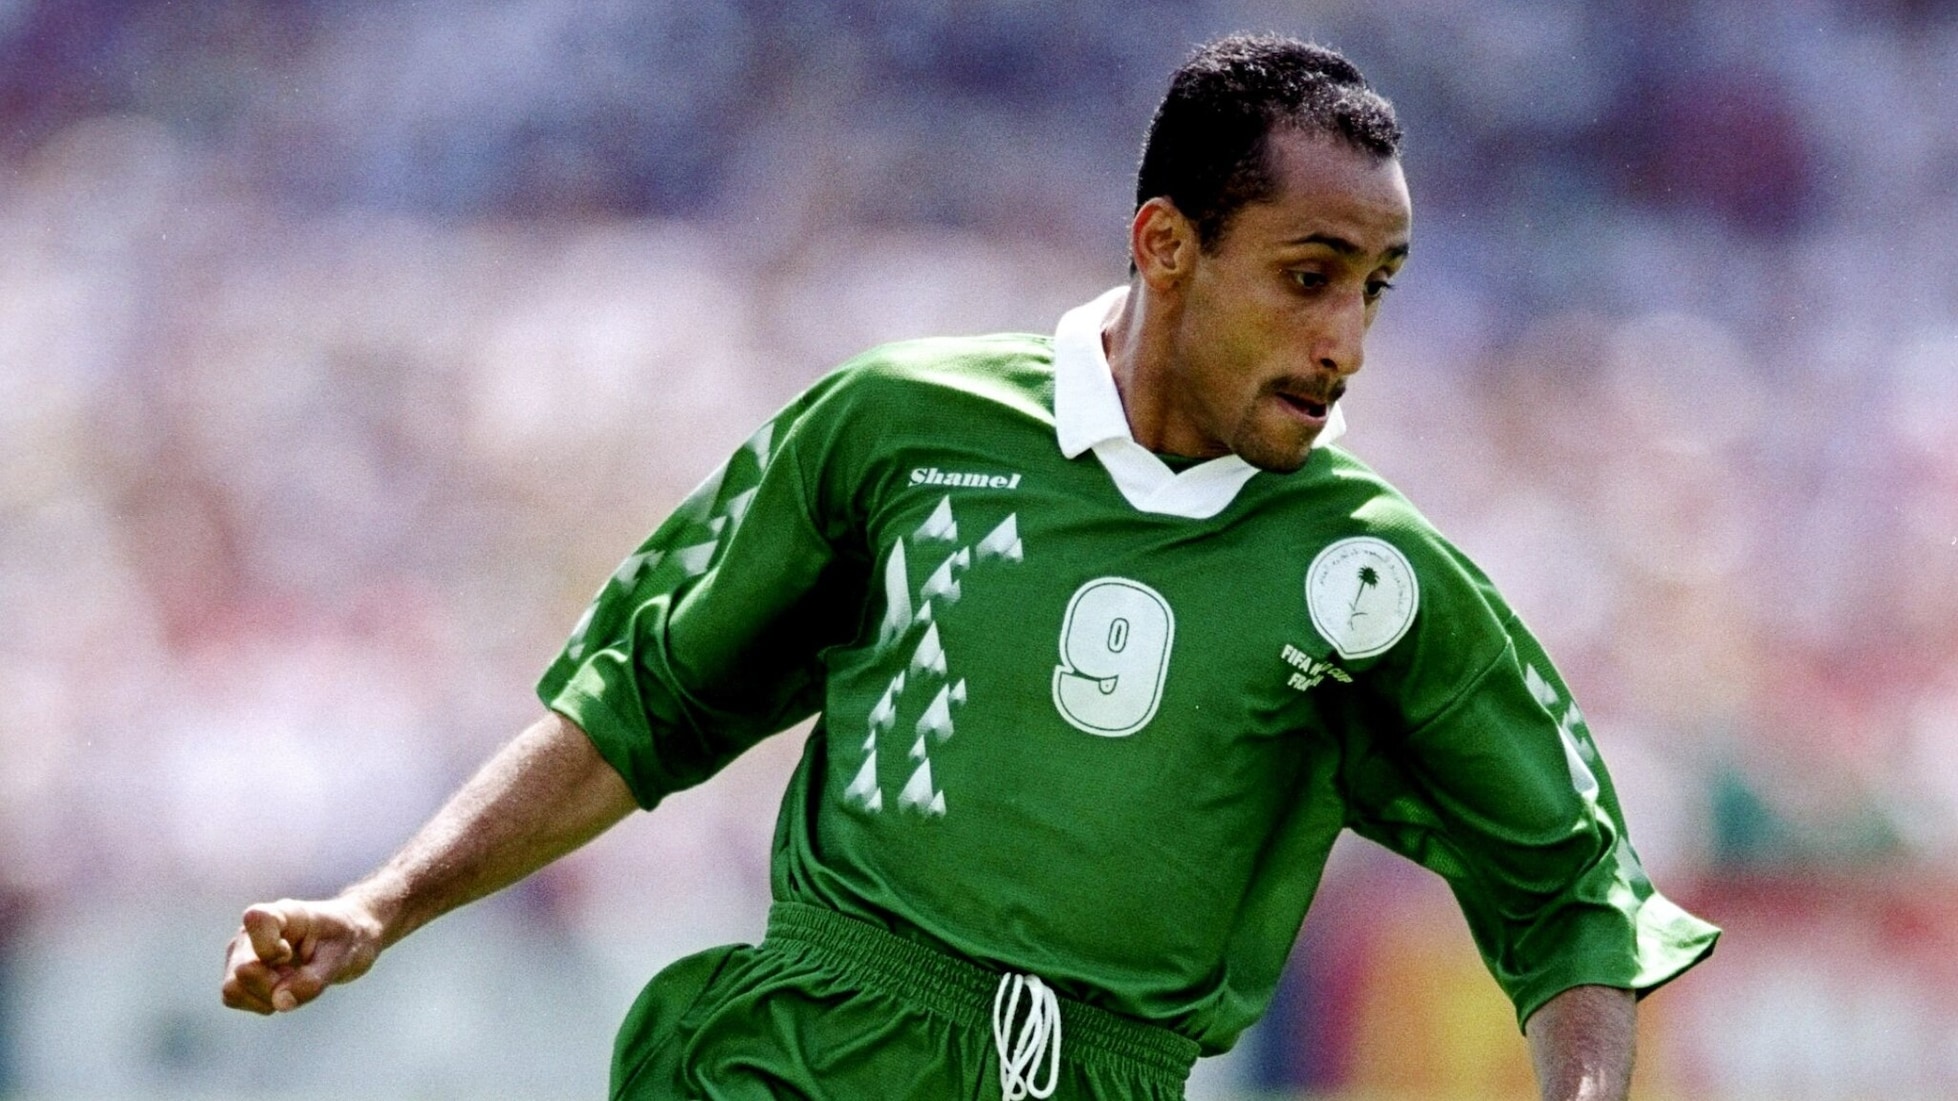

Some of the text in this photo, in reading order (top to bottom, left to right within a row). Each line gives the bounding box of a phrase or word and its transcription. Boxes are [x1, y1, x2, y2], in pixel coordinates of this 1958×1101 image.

[908, 468, 1022, 489] Shamel
[1052, 576, 1175, 737] 9
[1281, 644, 1312, 672] FIFA
